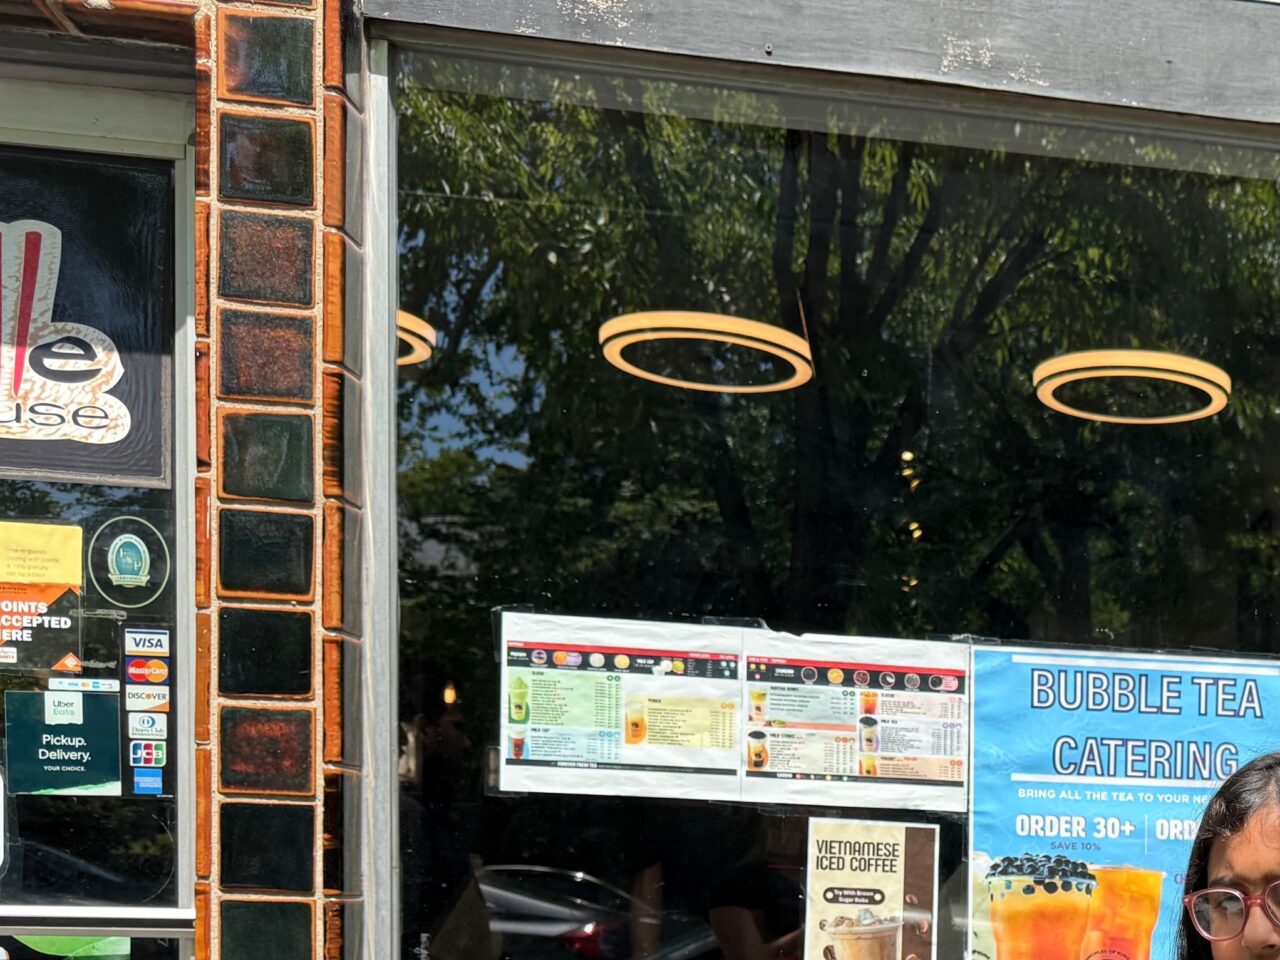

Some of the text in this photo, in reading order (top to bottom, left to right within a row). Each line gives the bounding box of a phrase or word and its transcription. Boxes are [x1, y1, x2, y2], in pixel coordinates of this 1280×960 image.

[0, 601, 48, 614] OINTS
[131, 636, 164, 649] VISA
[129, 666, 168, 677] MasterCard
[128, 692, 167, 700] DISCOVER
[1030, 668, 1264, 719] BUBBLE TEA
[52, 701, 74, 709] Uber
[42, 734, 87, 747] Pickup.
[38, 749, 92, 763] Delivery.
[132, 749, 163, 758] JCB
[1052, 735, 1240, 782] CATERING
[1018, 788, 1056, 800] BRING
[1058, 789, 1082, 801] ALL
[1084, 791, 1108, 801] THE
[1111, 791, 1133, 802] TEA
[1136, 792, 1154, 803] TO
[1157, 793, 1190, 804] YOUR
[1016, 814, 1136, 839] ORDER 30+
[1156, 818, 1199, 840] ORD
[815, 839, 900, 858] VIETNAMESE
[1050, 841, 1102, 851] SAVE 10%
[815, 855, 898, 873] ICED COFFEE
[834, 890, 843, 898] Try
